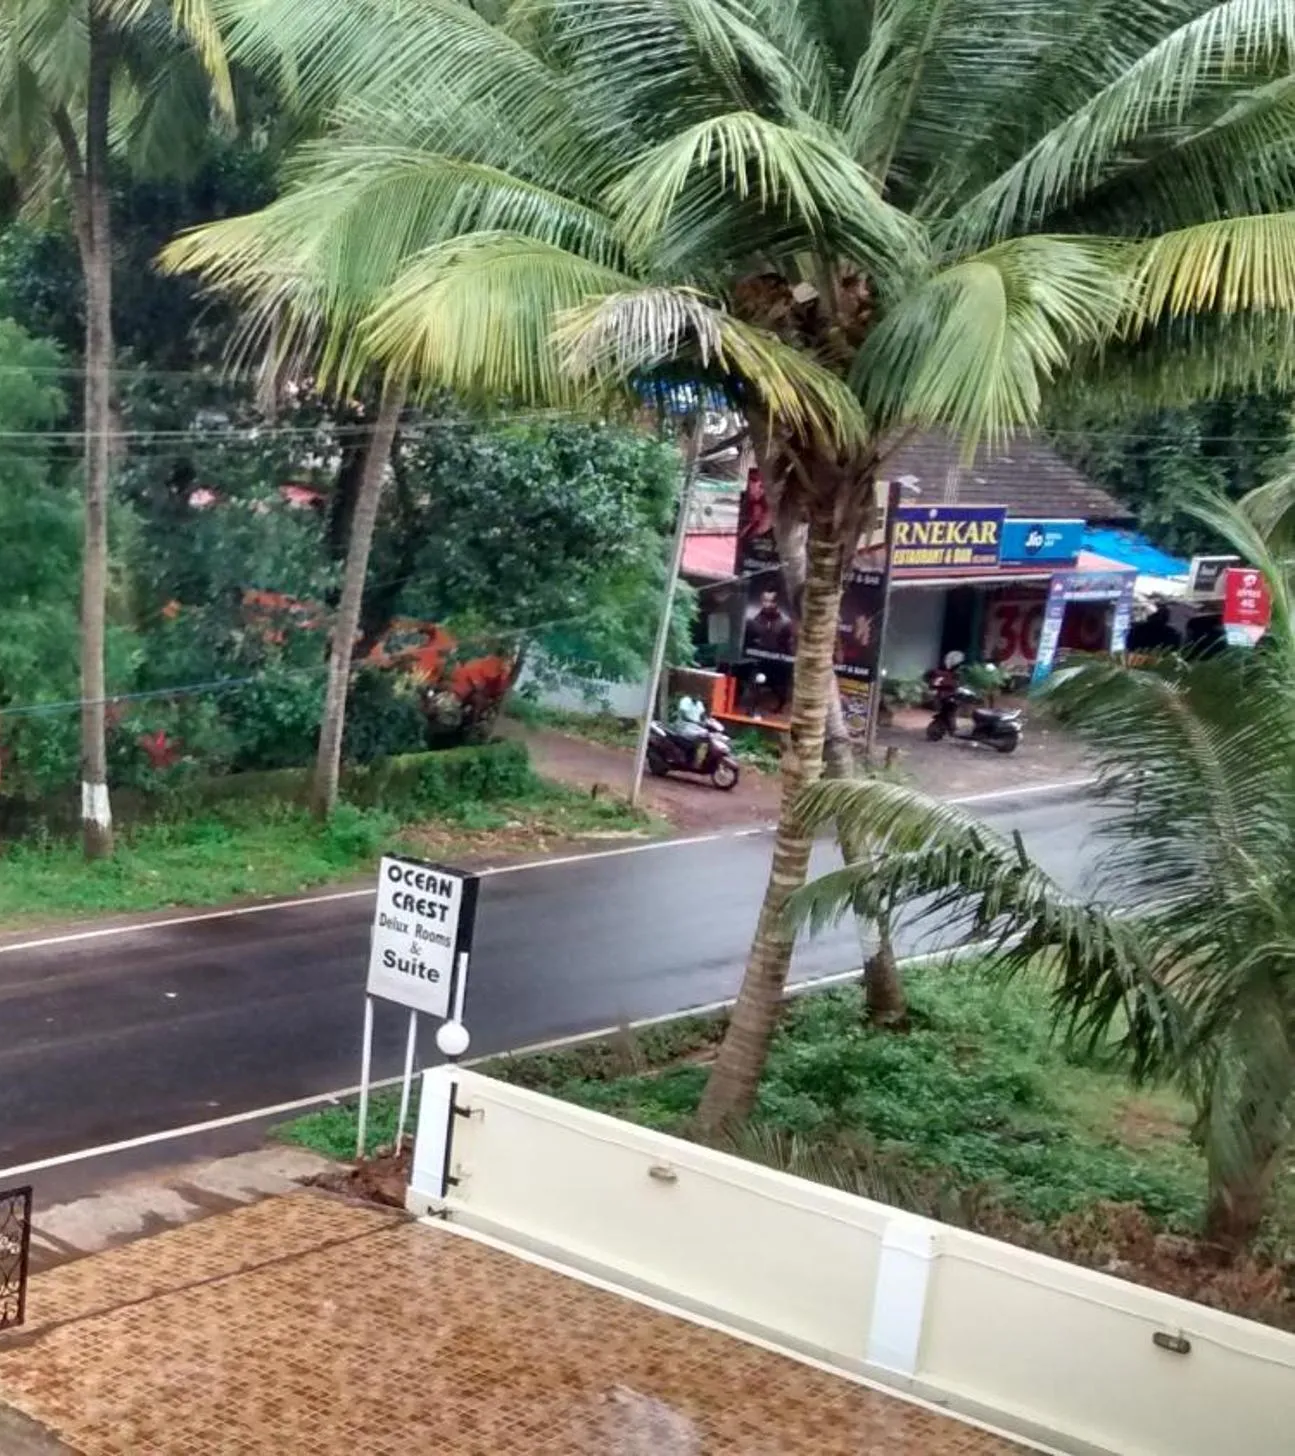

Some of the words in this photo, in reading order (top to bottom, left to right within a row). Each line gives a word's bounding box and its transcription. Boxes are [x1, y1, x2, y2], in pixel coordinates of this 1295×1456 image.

[388, 865, 453, 898] OCEAN
[392, 892, 449, 922] CREST
[379, 912, 409, 934] Delux
[415, 923, 452, 948] Rooms
[410, 941, 423, 956] &
[383, 949, 440, 983] Suite
